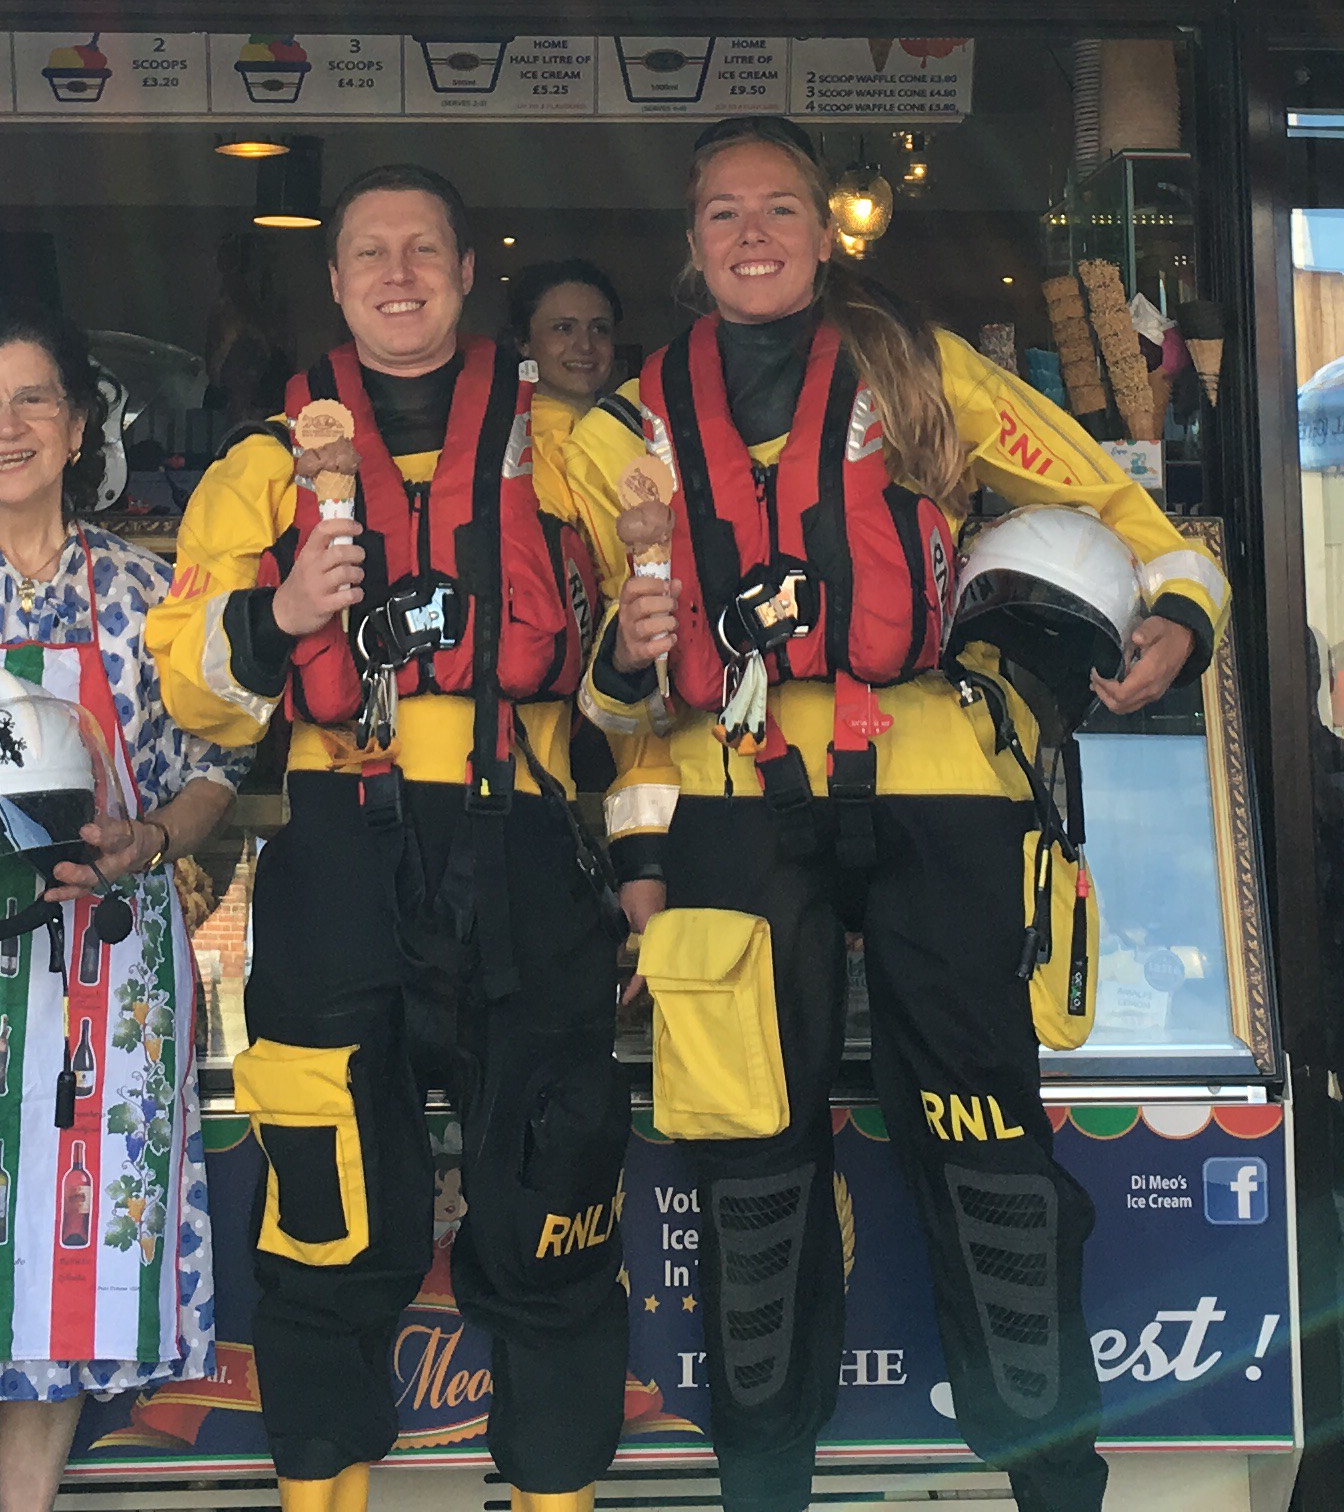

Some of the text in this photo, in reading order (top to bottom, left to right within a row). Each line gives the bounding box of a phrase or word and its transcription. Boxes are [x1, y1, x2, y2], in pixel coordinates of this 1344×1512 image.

[152, 37, 166, 53] 2
[349, 38, 361, 54] 3
[533, 39, 568, 50] HOME
[731, 39, 767, 50] HOME
[132, 59, 188, 71] SCOOPS
[328, 59, 384, 71] SCOOPS
[509, 54, 592, 65] HALF LITRE OF
[723, 55, 774, 65] LITRE OF
[520, 70, 581, 81] ICE CREAM
[717, 70, 779, 81] ICE CREAM
[805, 71, 928, 84] 2 SCOOP WAFFLE CONE
[141, 77, 180, 88] £3.20
[337, 77, 375, 88] £4.20
[532, 84, 569, 96] £5.25
[729, 85, 767, 97] £9.50
[805, 85, 816, 98] 3
[817, 89, 853, 99] SCOOP
[855, 89, 896, 99] WAFFLE
[897, 89, 927, 99] CONE
[805, 100, 926, 113] 4 SCOOP WAFFLE CONE
[1130, 1173, 1188, 1191] Di Meo's
[1126, 1194, 1193, 1209] Ice Cream
[664, 1260, 690, 1287] In
